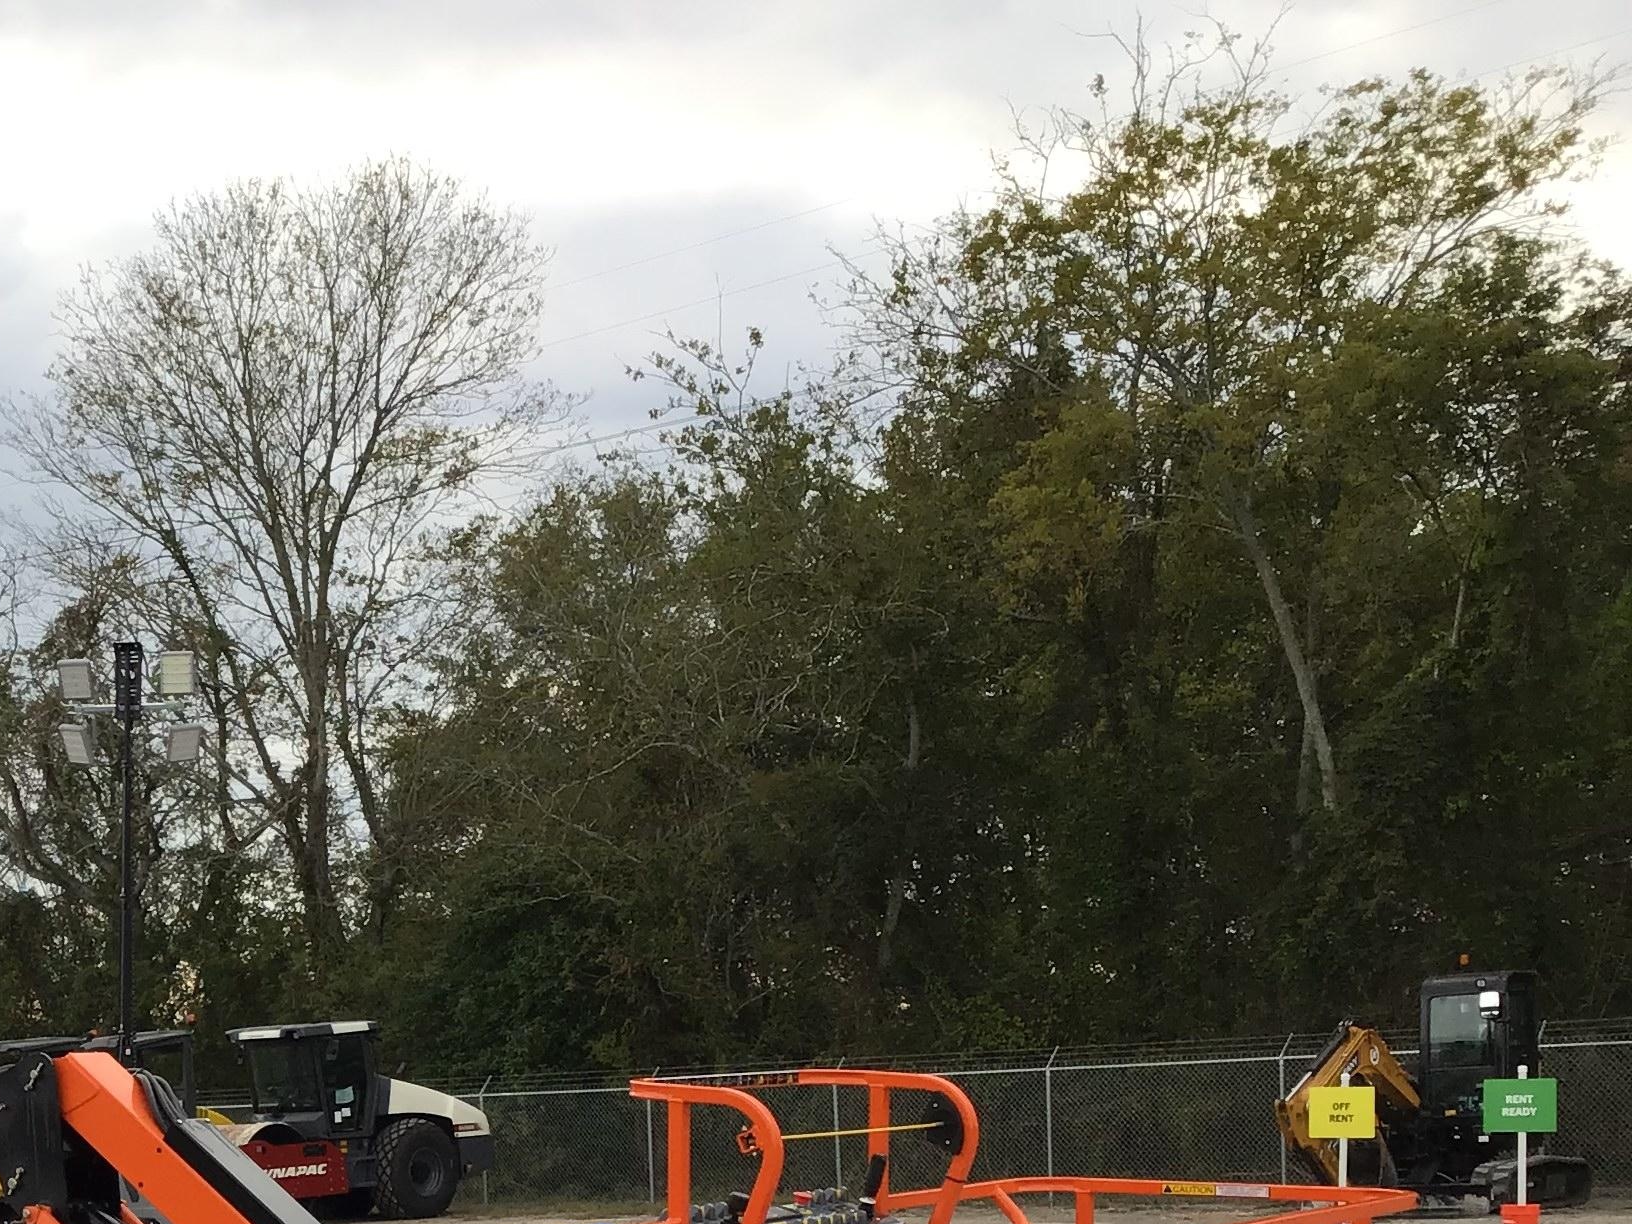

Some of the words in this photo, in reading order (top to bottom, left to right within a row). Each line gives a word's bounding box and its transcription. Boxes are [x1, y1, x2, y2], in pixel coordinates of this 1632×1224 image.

[1505, 1094, 1534, 1104] RENT
[1332, 1102, 1351, 1111] OFF
[1501, 1107, 1537, 1117] READY
[1329, 1114, 1354, 1123] RENT
[264, 1163, 328, 1179] YNAPAC
[1172, 1184, 1214, 1194] CAUTION
